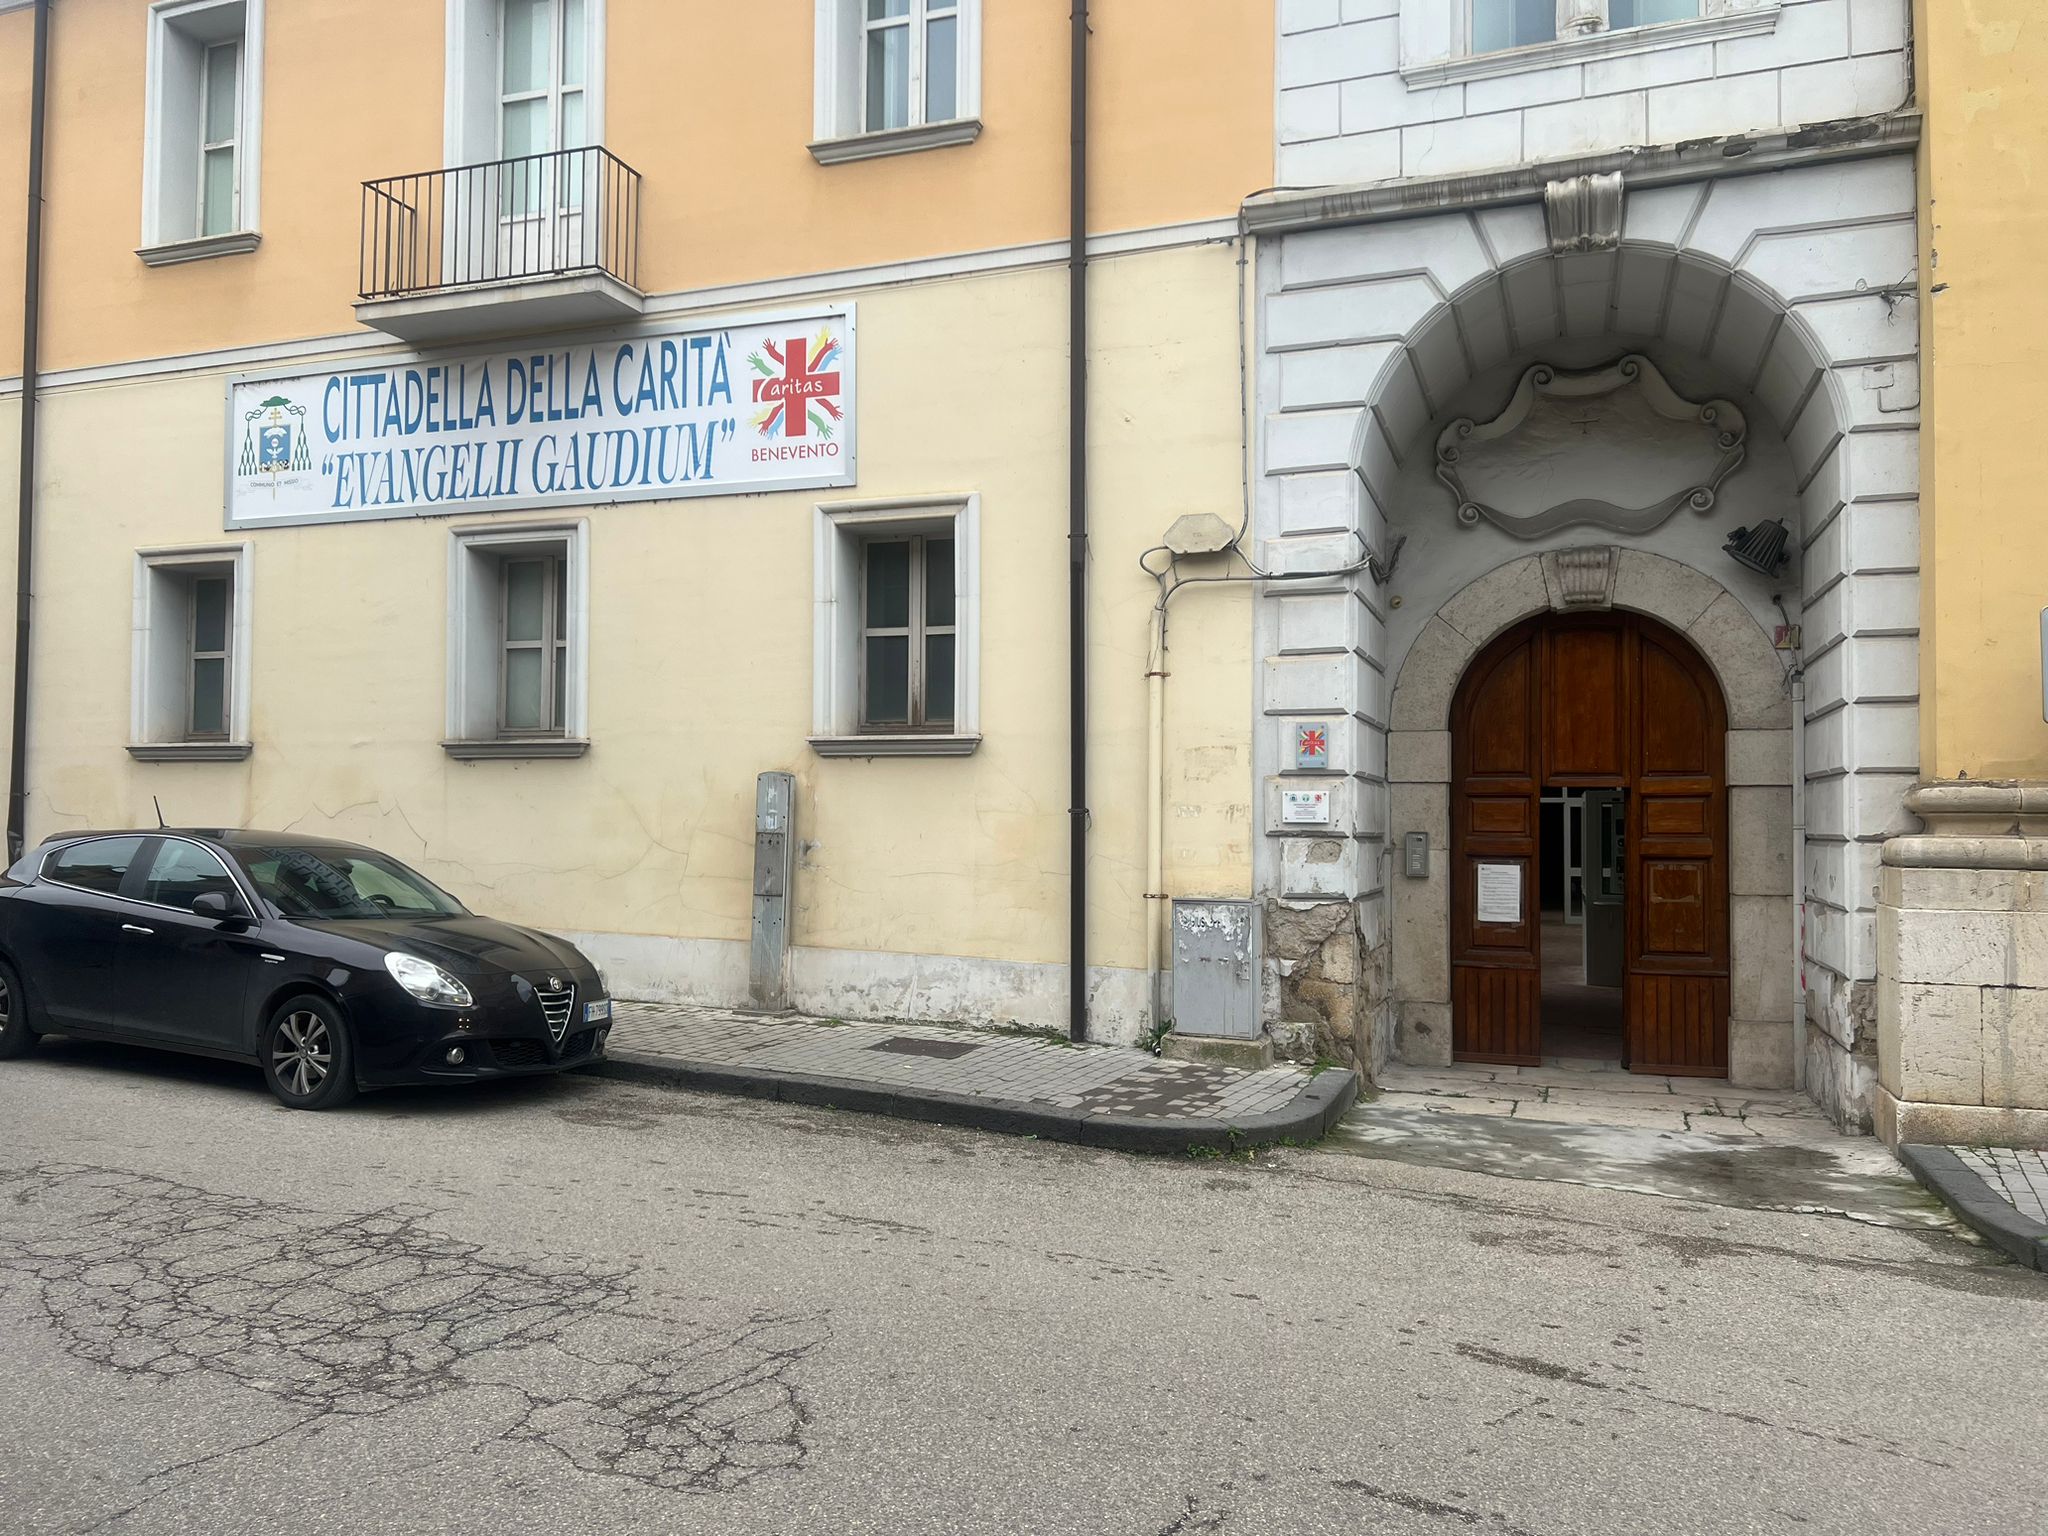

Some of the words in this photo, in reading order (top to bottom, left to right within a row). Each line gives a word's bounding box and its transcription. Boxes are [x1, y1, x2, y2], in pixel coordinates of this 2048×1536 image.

[323, 361, 496, 443] CITTADELLA
[506, 349, 603, 425] DELLA
[613, 332, 732, 416] CARITÀ
[321, 439, 524, 507] “EVANGELII
[531, 417, 736, 494] GAUDIUM”
[751, 442, 839, 462] BENEVENTO
